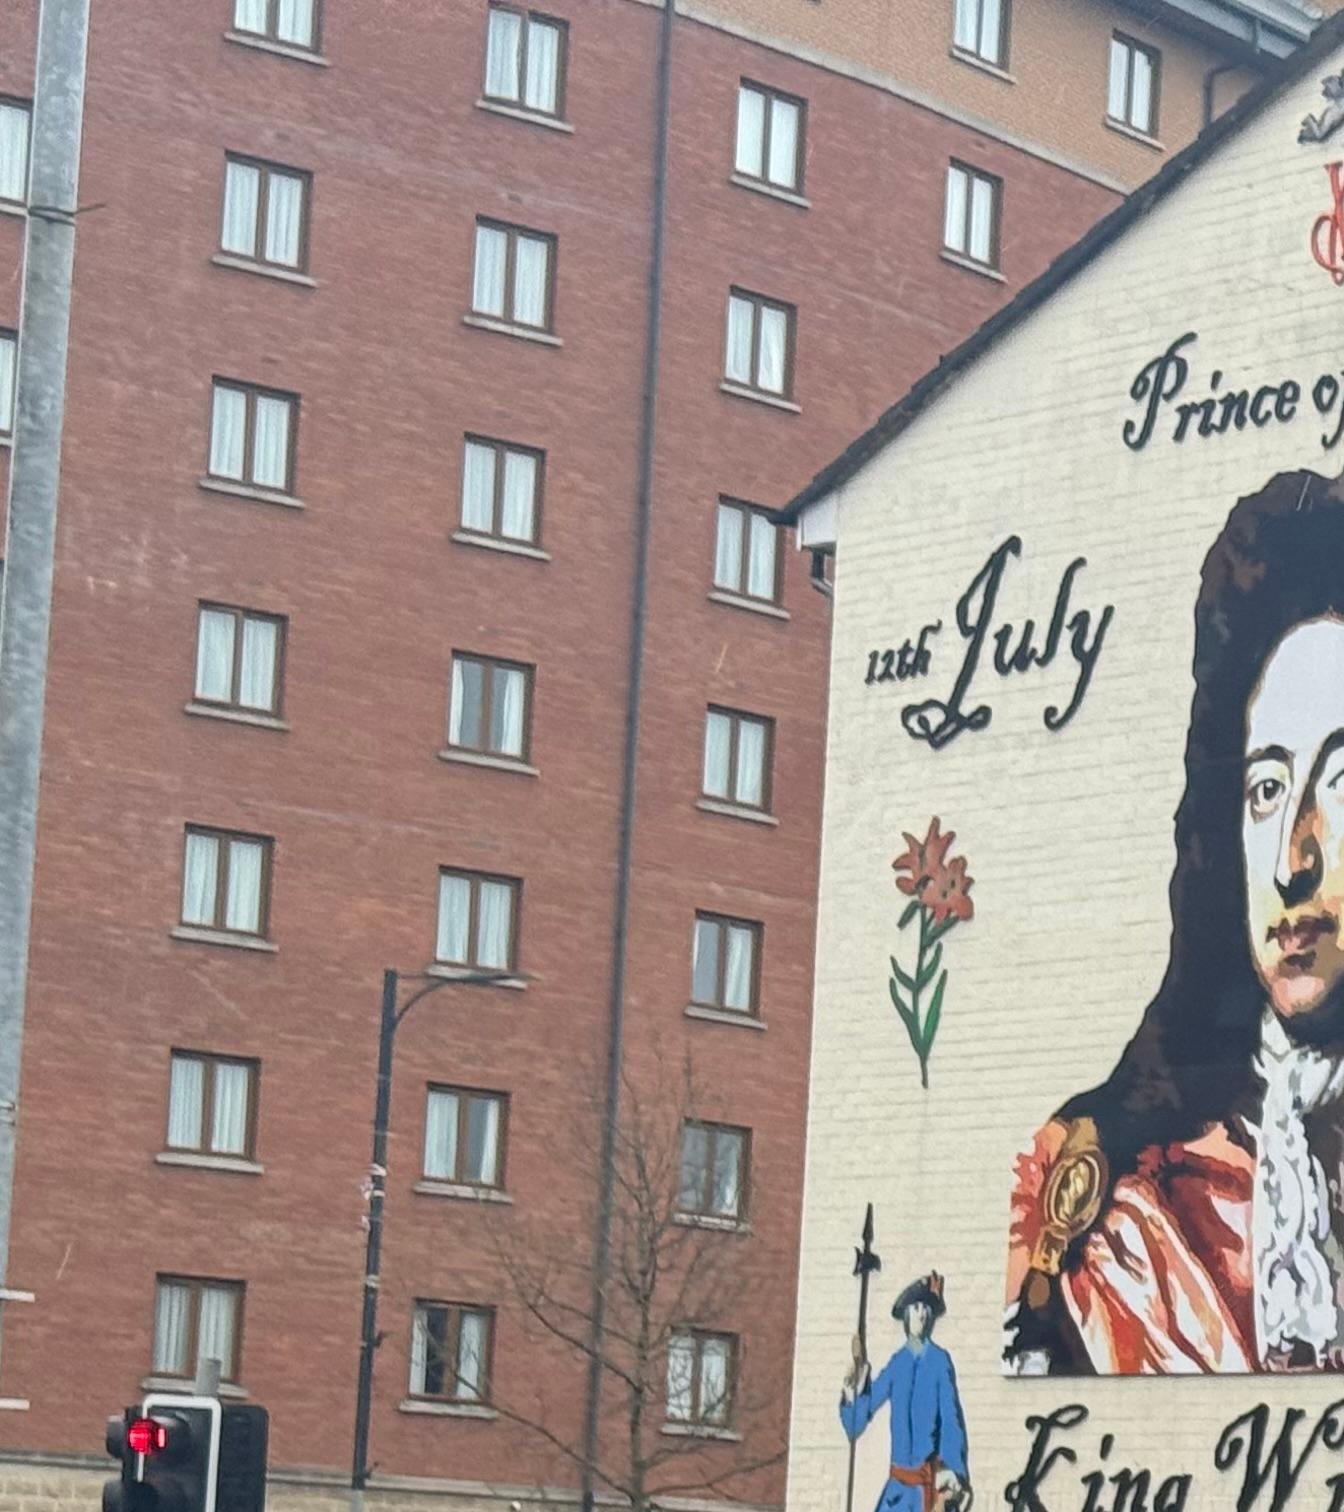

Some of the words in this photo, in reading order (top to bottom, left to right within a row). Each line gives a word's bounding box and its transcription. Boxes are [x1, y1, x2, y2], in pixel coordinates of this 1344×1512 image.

[1122, 332, 1300, 451] Prince
[864, 618, 943, 685] 12th
[901, 535, 1115, 749] July
